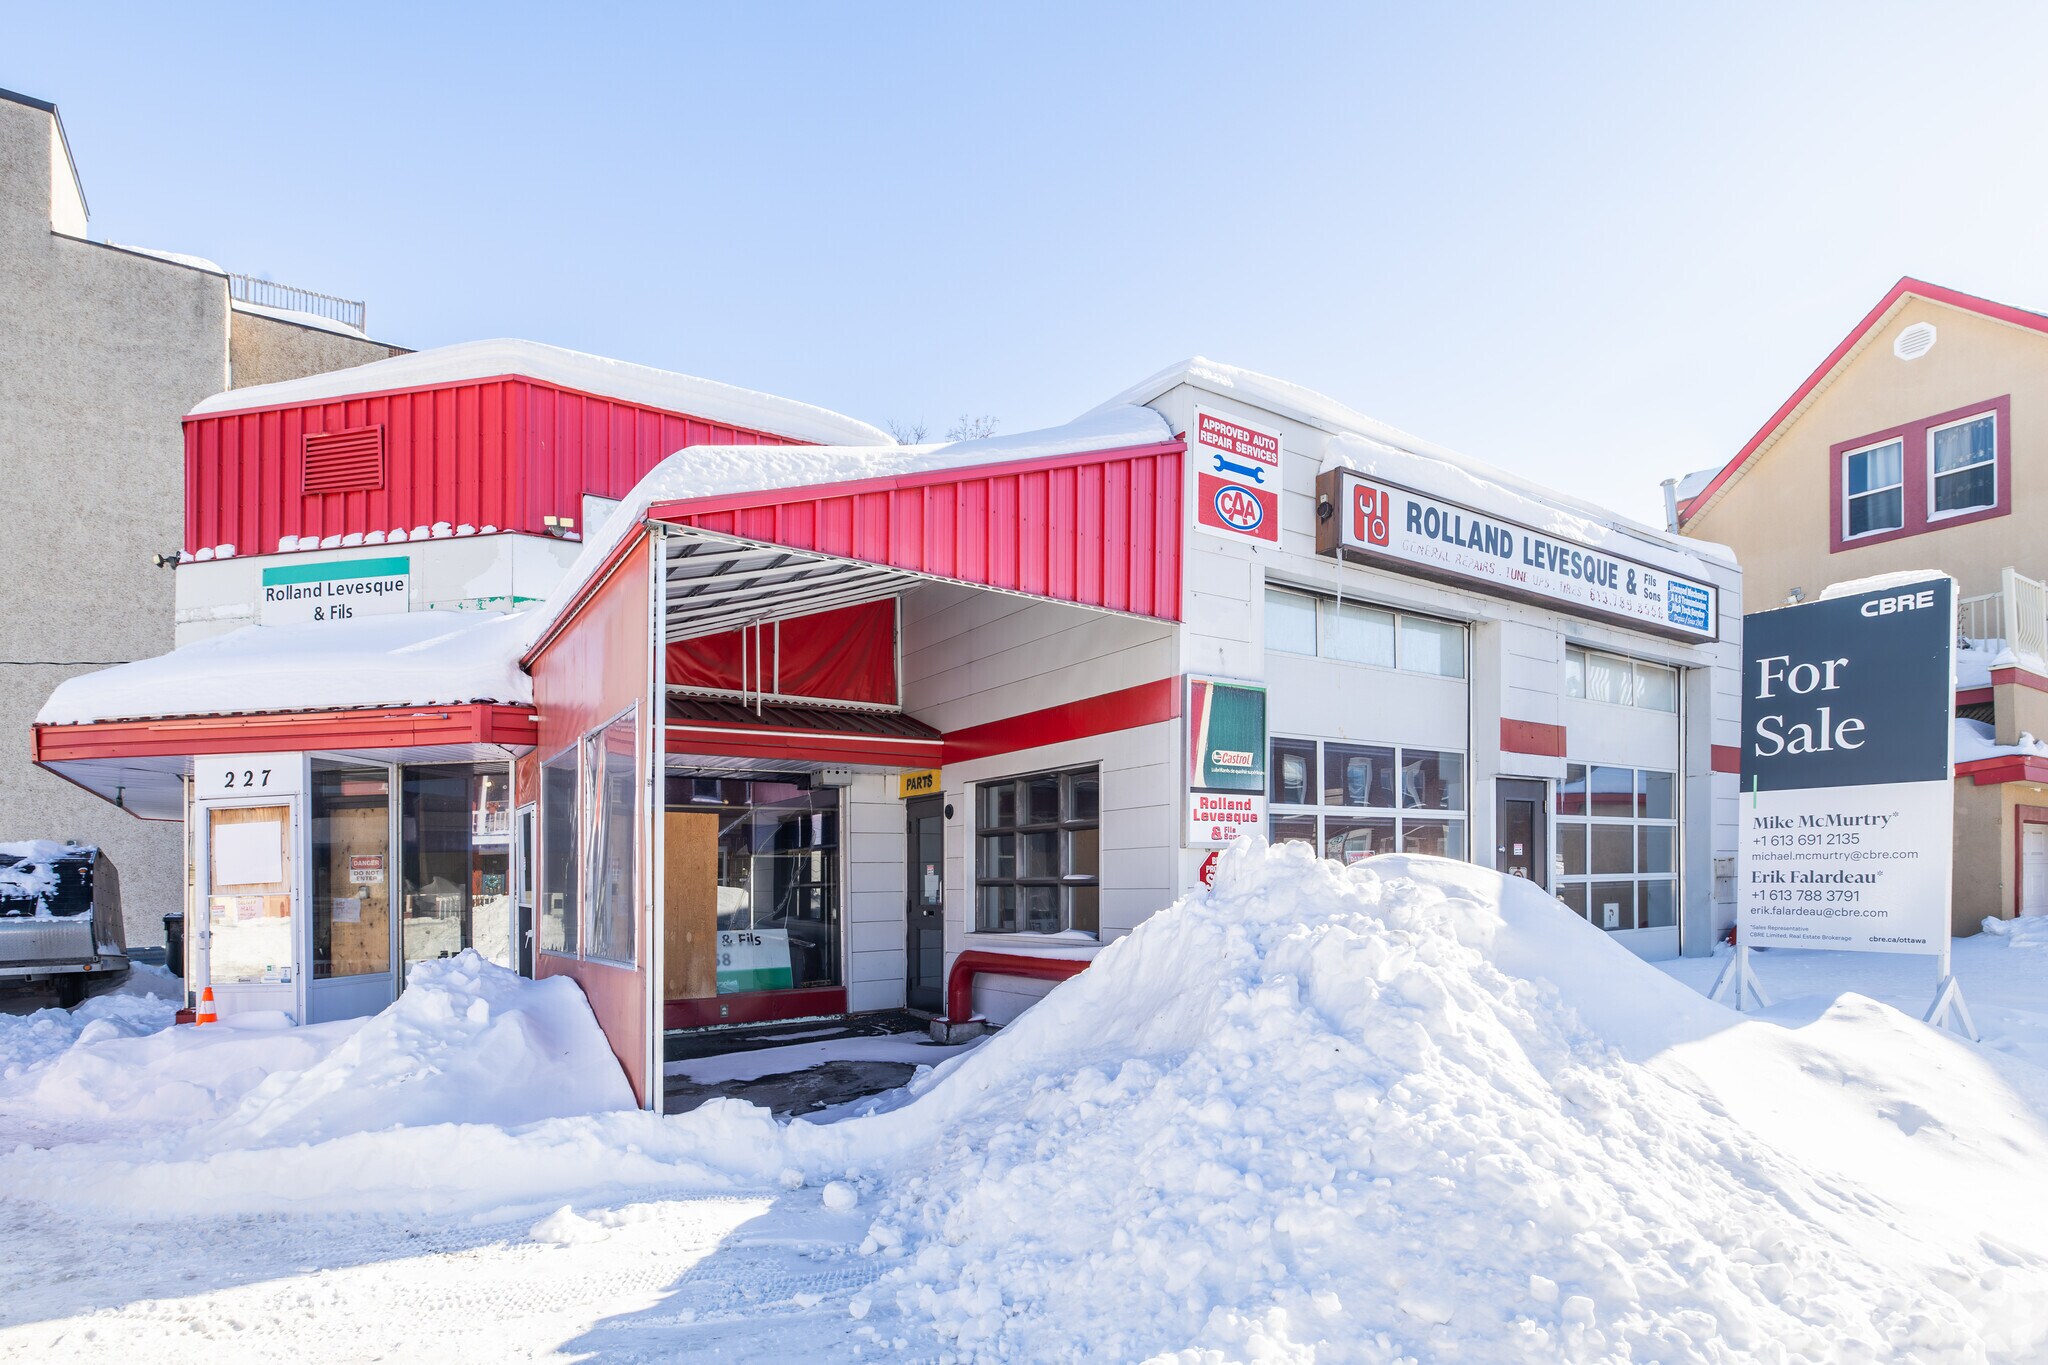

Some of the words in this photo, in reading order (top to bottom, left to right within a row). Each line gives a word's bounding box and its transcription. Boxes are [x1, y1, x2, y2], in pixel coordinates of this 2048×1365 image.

[1202, 418, 1250, 442] APPROVED
[1254, 435, 1276, 450] AUTO
[1200, 430, 1232, 450] REPAIR
[1236, 442, 1276, 464] SERVICES
[1220, 492, 1256, 525] CAA
[1406, 500, 1513, 559] ROLLAND
[1523, 536, 1618, 590] LEVESQUE
[1626, 568, 1637, 596] &
[1644, 573, 1657, 587] Fils
[266, 582, 322, 602] Rolland
[328, 580, 404, 596] Levesque
[1644, 588, 1661, 602] Sons
[1860, 590, 1935, 618] CBRE
[314, 606, 324, 621] &
[330, 604, 352, 620] Fils
[1755, 655, 1849, 700] For
[1755, 706, 1866, 757] Sale
[1222, 752, 1250, 765] Castrol
[224, 769, 272, 788] 227
[906, 774, 933, 791] PARTS
[1200, 796, 1252, 812] Rolland
[1193, 808, 1258, 825] Levesque
[1753, 816, 1794, 830] Mike
[1211, 826, 1223, 840] &
[1753, 836, 1766, 846] +1
[1770, 834, 1794, 846] 613
[1798, 834, 1822, 846] 691
[1826, 832, 1860, 845] 2135
[1752, 850, 1918, 862] michael.mcmurtry@cbre.com
[1751, 870, 1786, 884] Erik
[1752, 890, 1764, 900] +1
[1769, 890, 1792, 901] 613
[1796, 890, 1822, 902] 788
[1826, 890, 1860, 902] 3791
[1750, 906, 1888, 918] erik.falardeau@cbre.com
[722, 934, 732, 946] &
[738, 932, 762, 946] Fils
[1868, 936, 1926, 944] cbre.ca/ottawa
